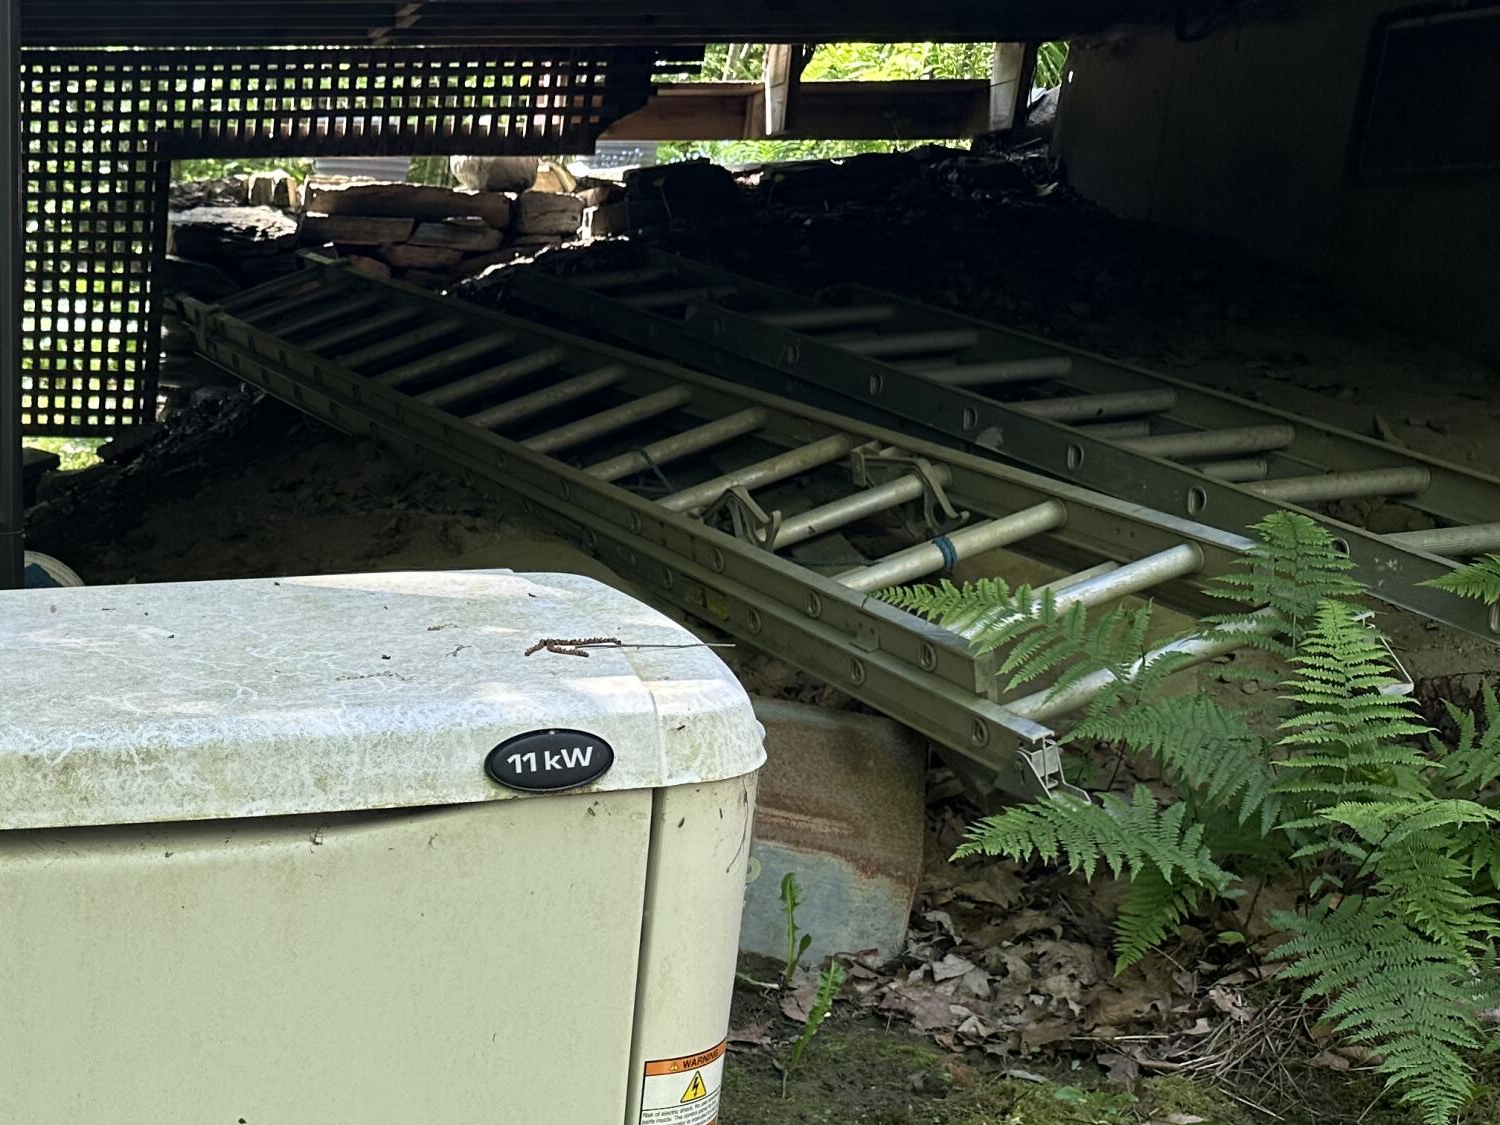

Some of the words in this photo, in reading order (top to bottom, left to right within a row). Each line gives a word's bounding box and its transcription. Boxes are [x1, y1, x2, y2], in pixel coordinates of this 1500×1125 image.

[507, 752, 537, 774] 11
[544, 746, 593, 770] kW
[683, 1049, 719, 1069] WARNING
